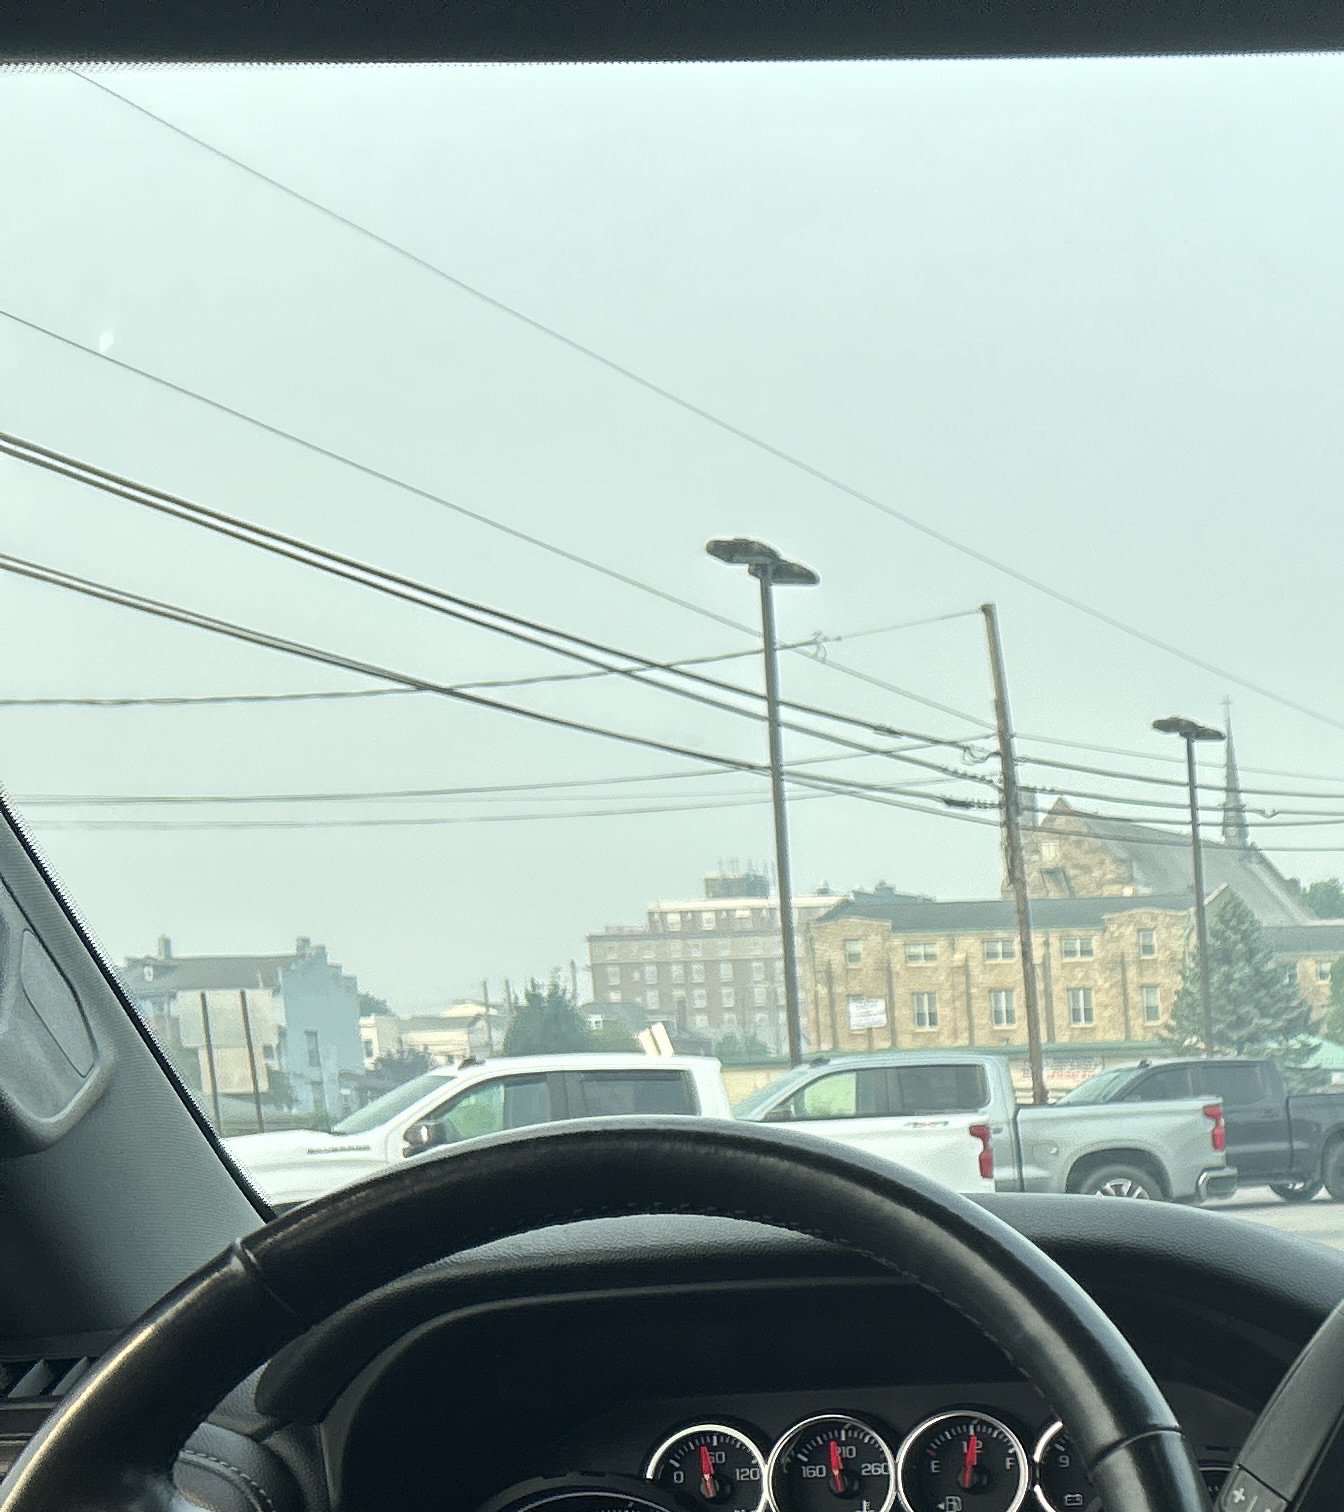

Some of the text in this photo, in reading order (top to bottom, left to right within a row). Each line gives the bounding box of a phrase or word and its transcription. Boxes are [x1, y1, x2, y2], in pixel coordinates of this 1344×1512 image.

[931, 1460, 941, 1473] E
[1006, 1457, 1015, 1470] F
[1058, 1455, 1070, 1468] 9
[673, 1471, 685, 1484] 0
[735, 1467, 761, 1481] 120
[802, 1465, 827, 1478] 160
[861, 1462, 889, 1476] 260
